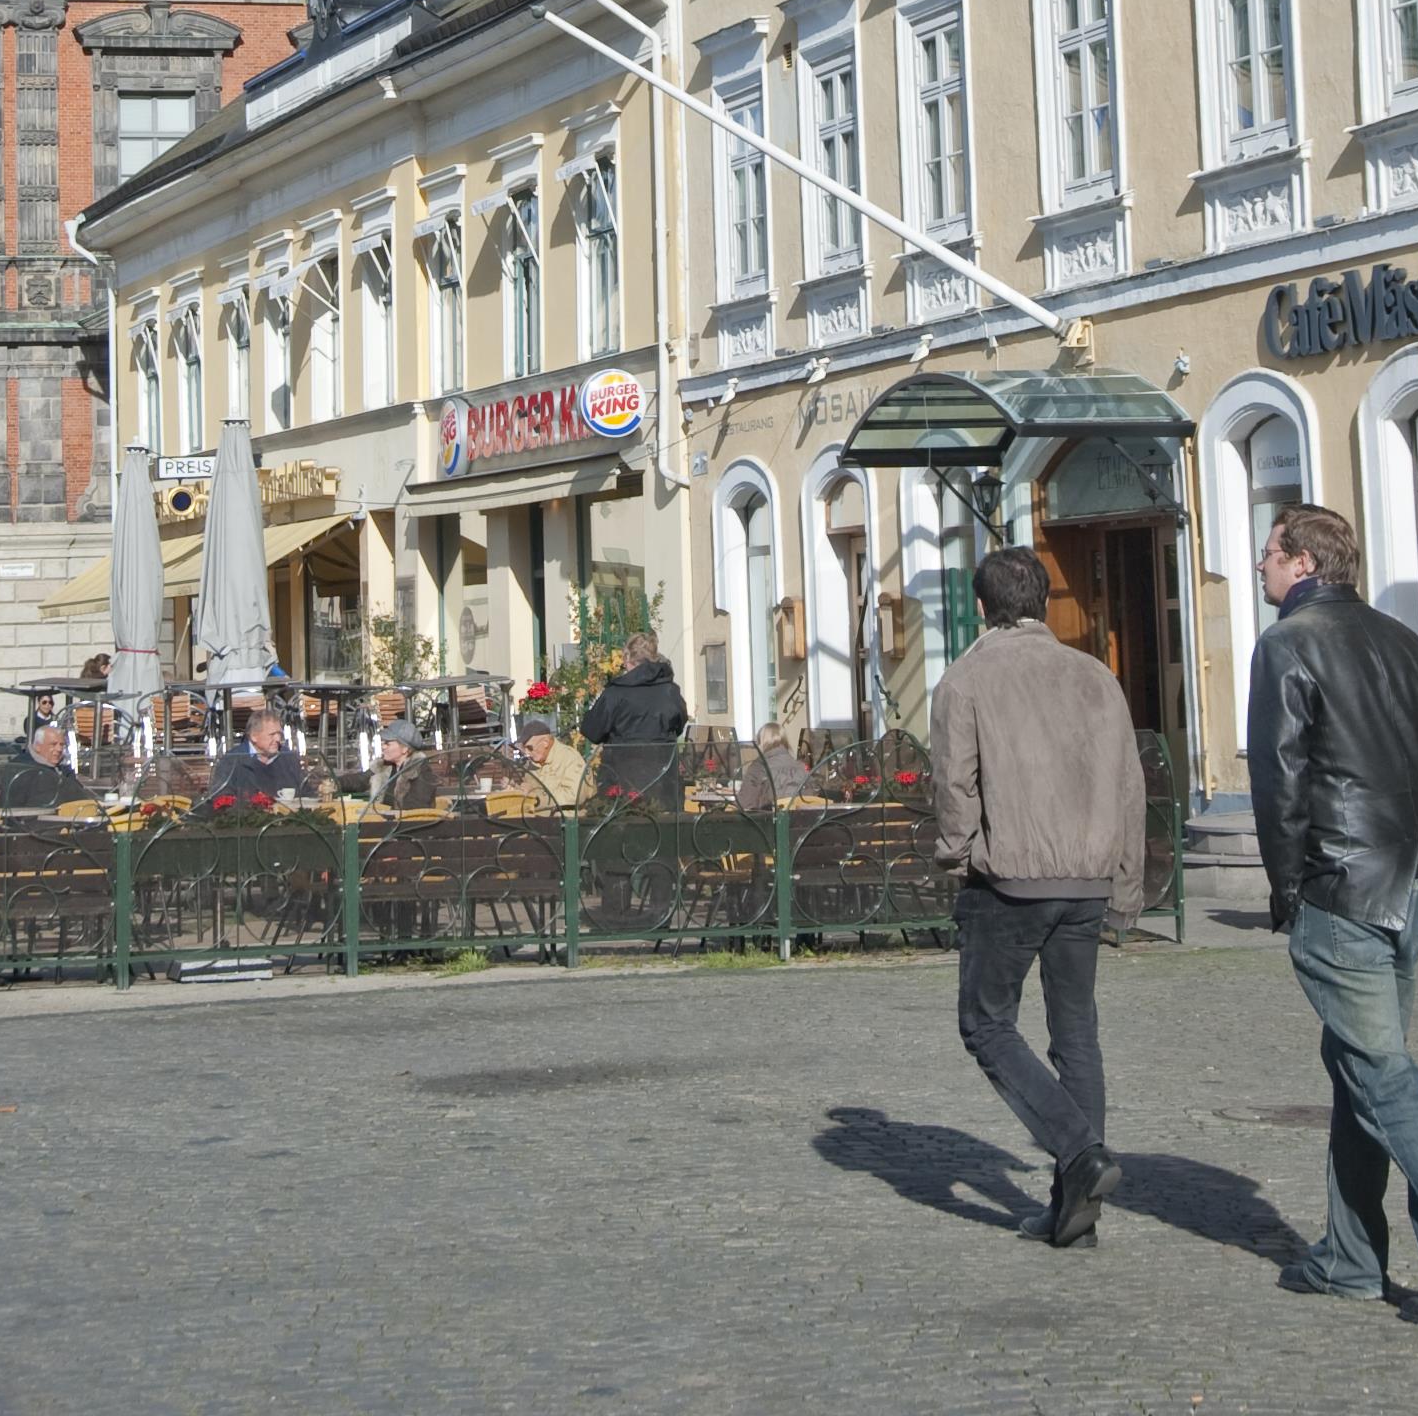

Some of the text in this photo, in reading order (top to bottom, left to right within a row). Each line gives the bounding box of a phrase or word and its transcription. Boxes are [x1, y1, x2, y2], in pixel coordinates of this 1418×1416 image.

[1263, 276, 1345, 360] Café
[590, 383, 638, 402] BURGER
[591, 395, 640, 419] KING
[467, 390, 555, 461] BURGER
